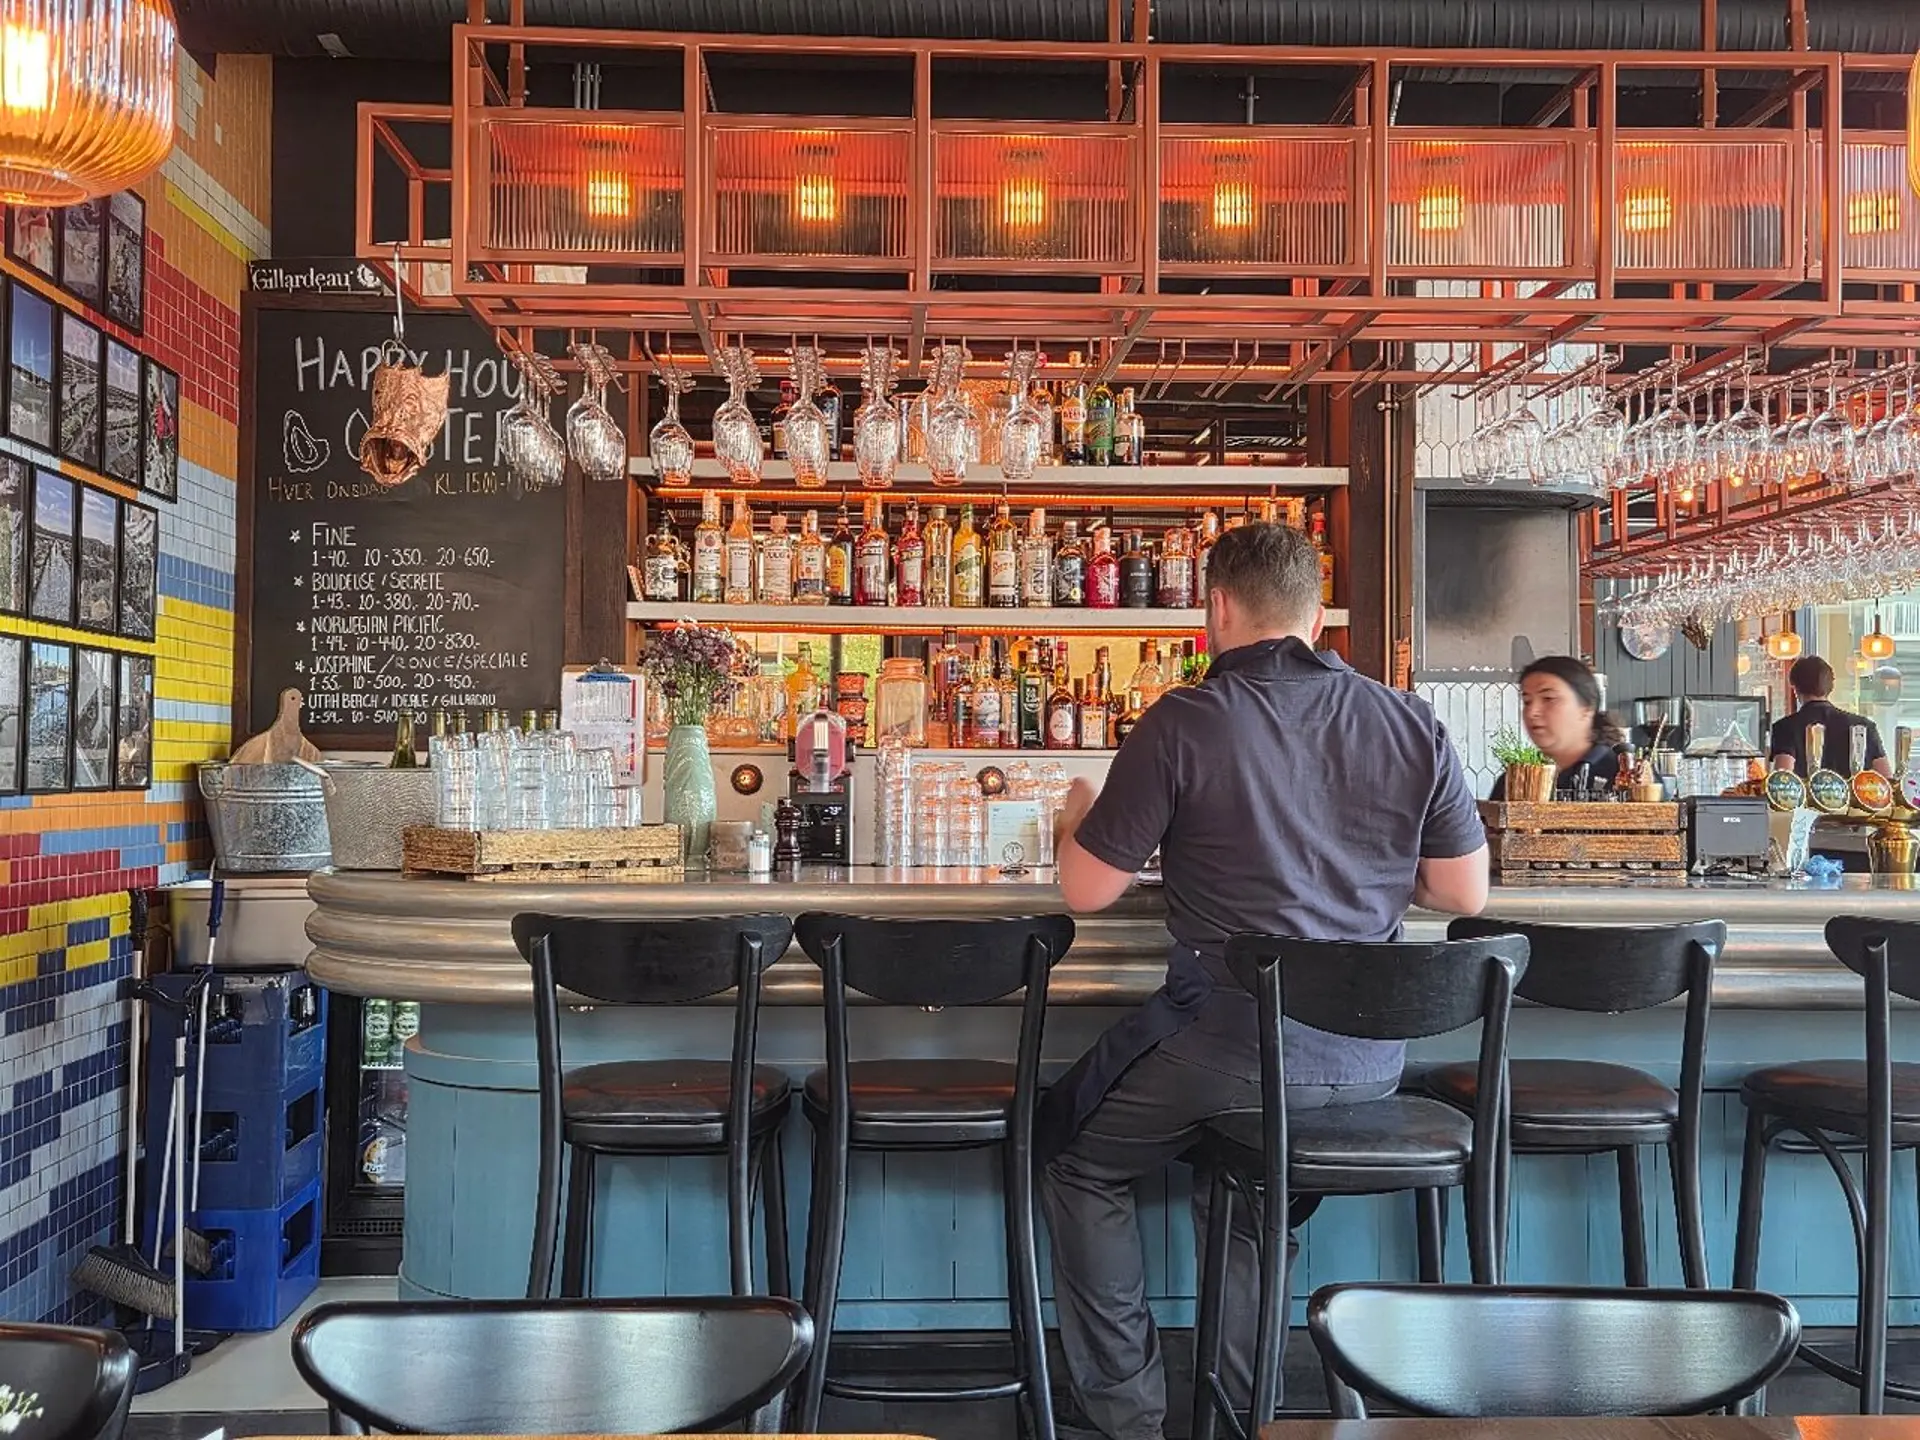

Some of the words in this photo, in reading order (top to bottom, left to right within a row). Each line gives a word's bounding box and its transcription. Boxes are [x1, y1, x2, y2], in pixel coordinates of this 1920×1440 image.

[252, 267, 352, 293] Gillardeau
[446, 349, 523, 398] HOU
[312, 522, 357, 546] FINE
[311, 615, 388, 634] NORWEGIAN
[393, 614, 445, 633] PACIFIC
[309, 655, 376, 674] JOSEPHINE
[308, 693, 340, 709] UTAH
